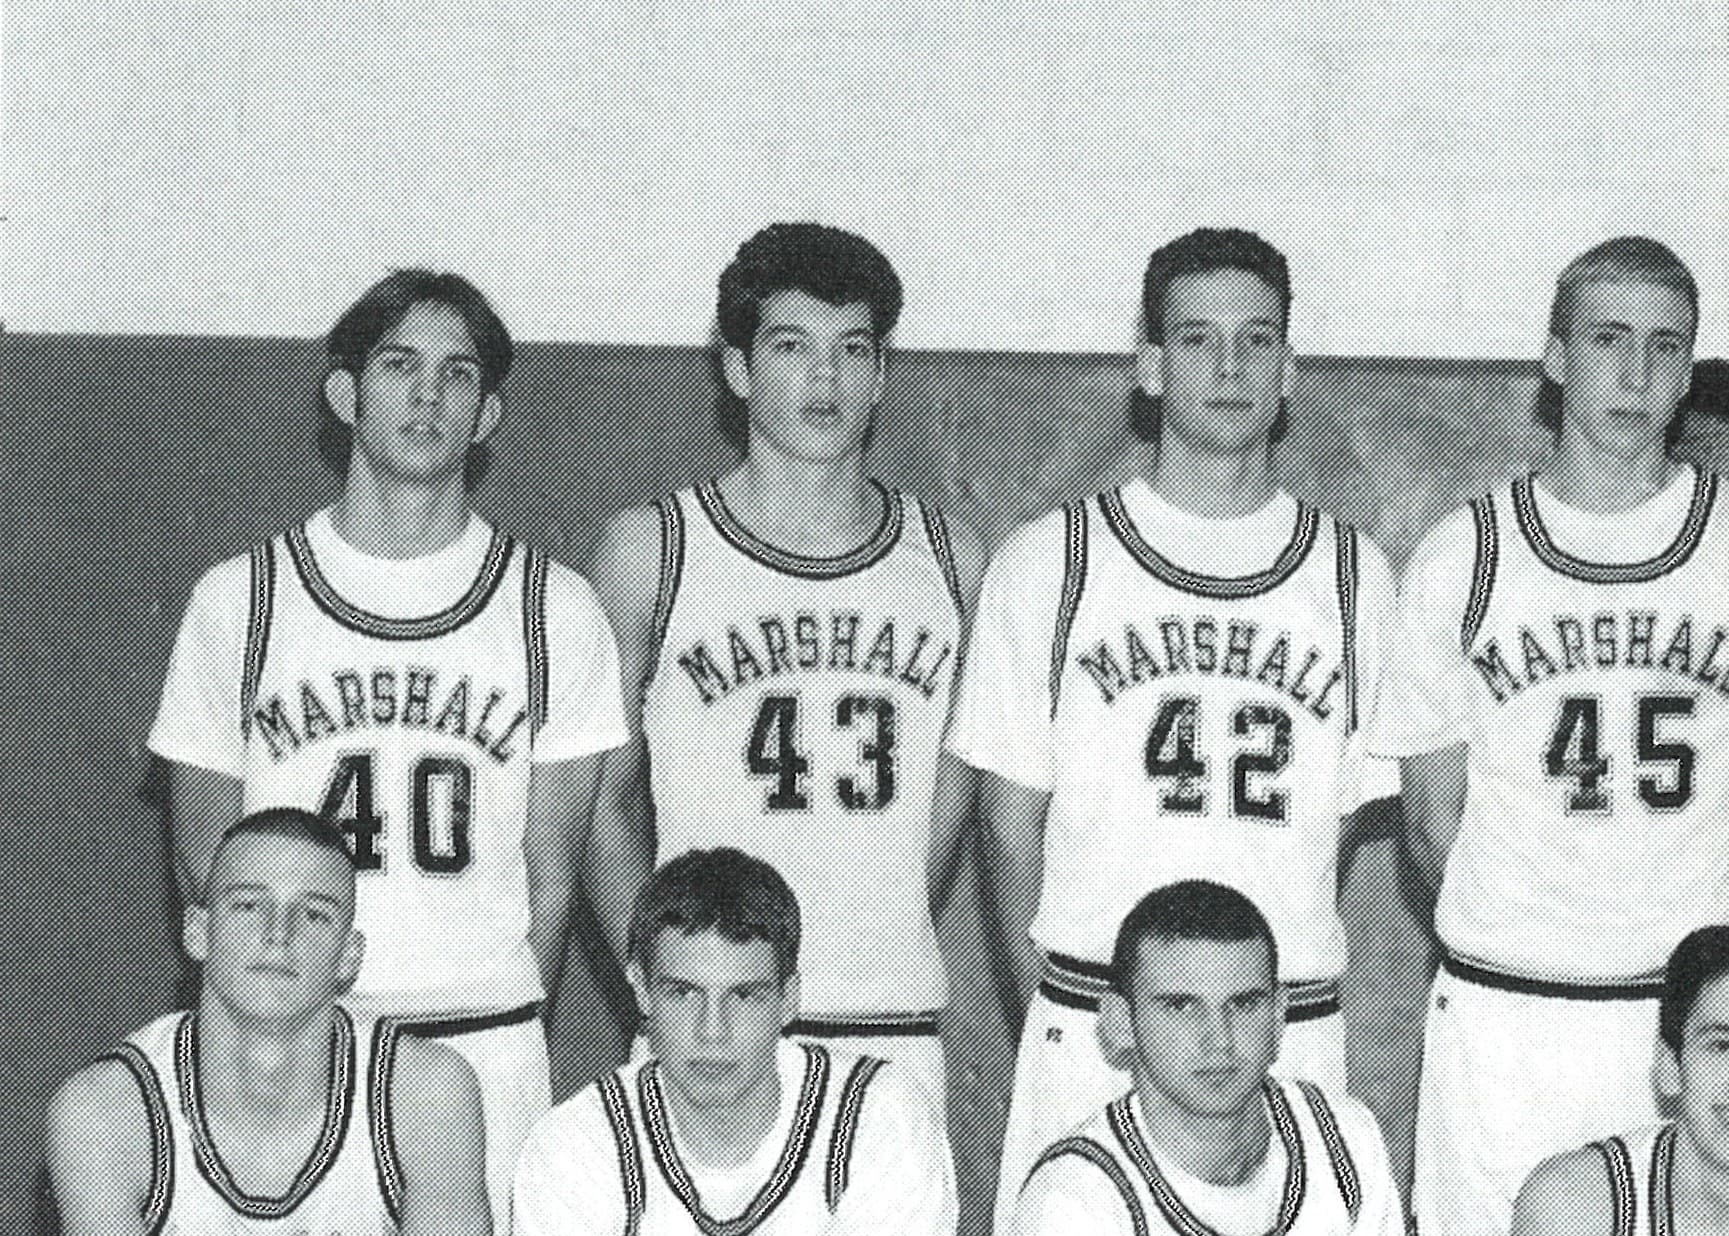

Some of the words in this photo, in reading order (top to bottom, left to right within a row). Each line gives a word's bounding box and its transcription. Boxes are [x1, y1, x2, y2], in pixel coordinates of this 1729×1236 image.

[253, 672, 532, 765] MARSHALL
[678, 612, 954, 702] MARSHALL
[1076, 616, 1344, 720] MARSHALL
[316, 752, 476, 876] 40
[743, 692, 903, 815] 43
[1142, 692, 1294, 824] 42
[1543, 690, 1698, 816] 45
